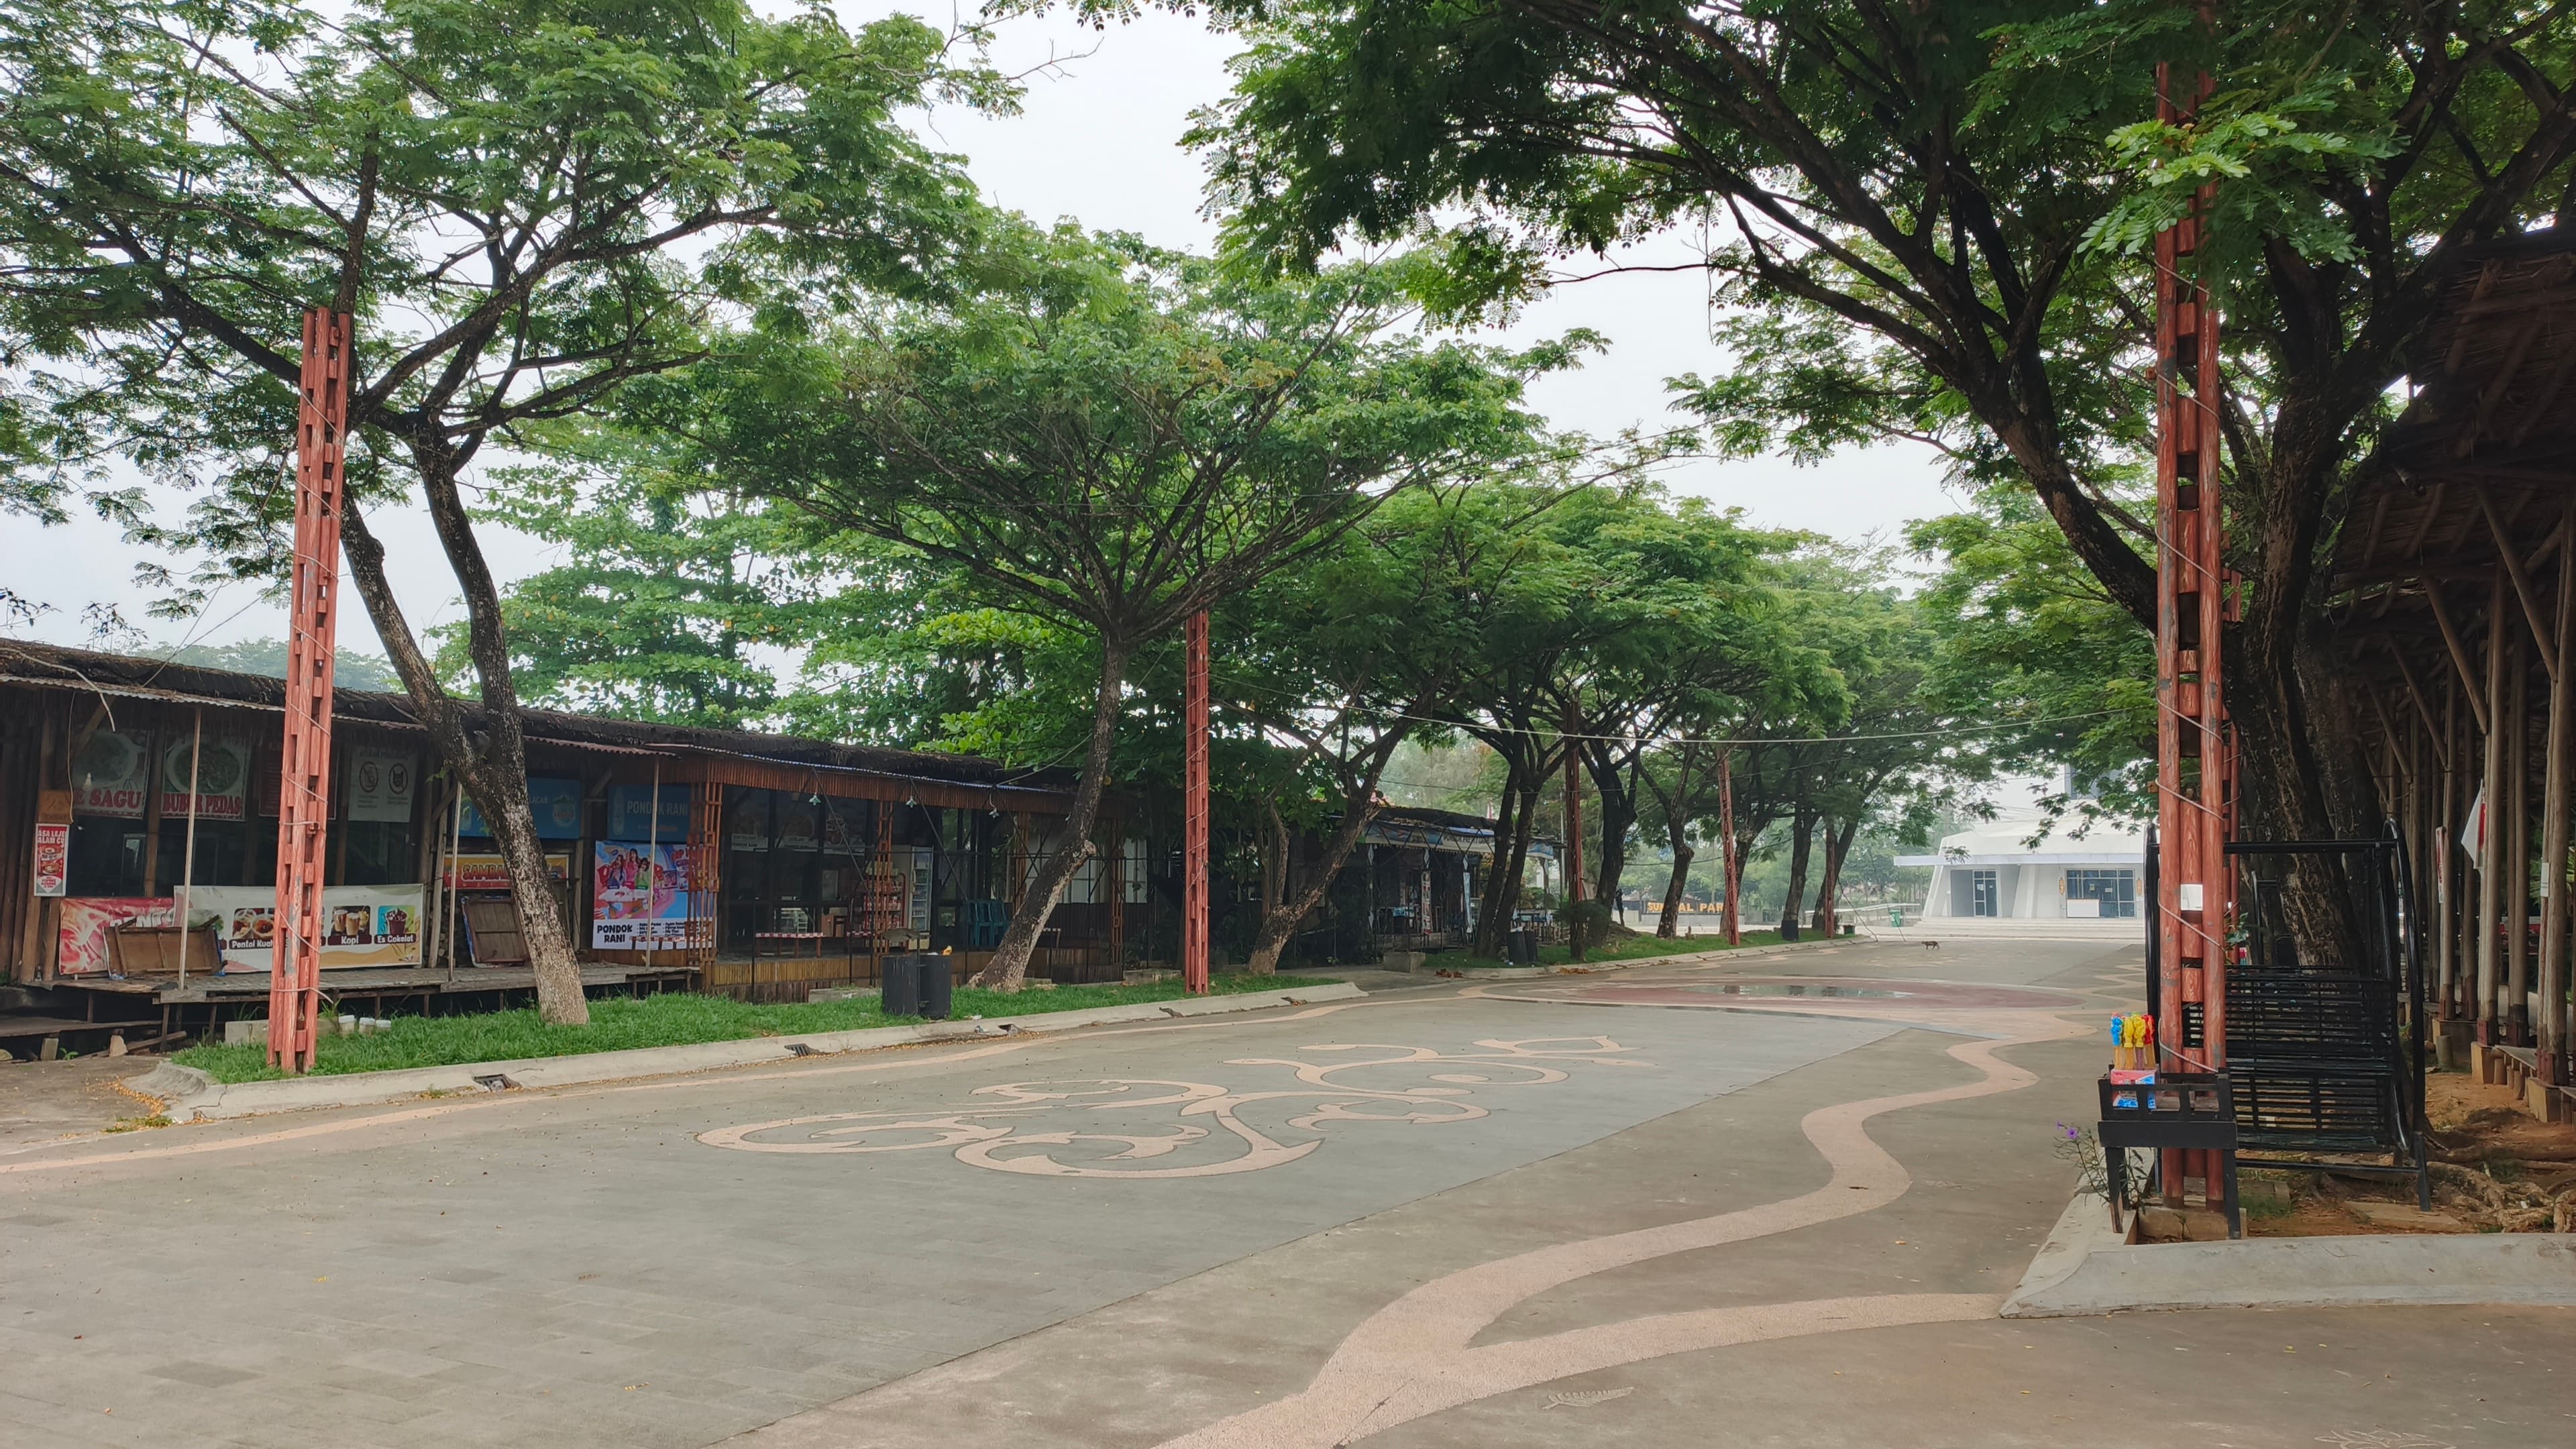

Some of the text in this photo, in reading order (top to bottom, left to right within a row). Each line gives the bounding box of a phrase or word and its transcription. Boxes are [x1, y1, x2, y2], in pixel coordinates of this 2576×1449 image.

[89, 788, 142, 809] SAGU
[162, 792, 242, 815] BUBR PEDAS
[627, 800, 688, 816] PONDK RANI
[1699, 902, 1724, 913] PAR
[597, 924, 633, 934] PONDOK
[341, 936, 359, 945] Kopi
[377, 935, 386, 943] Es
[604, 934, 625, 943] RANI
